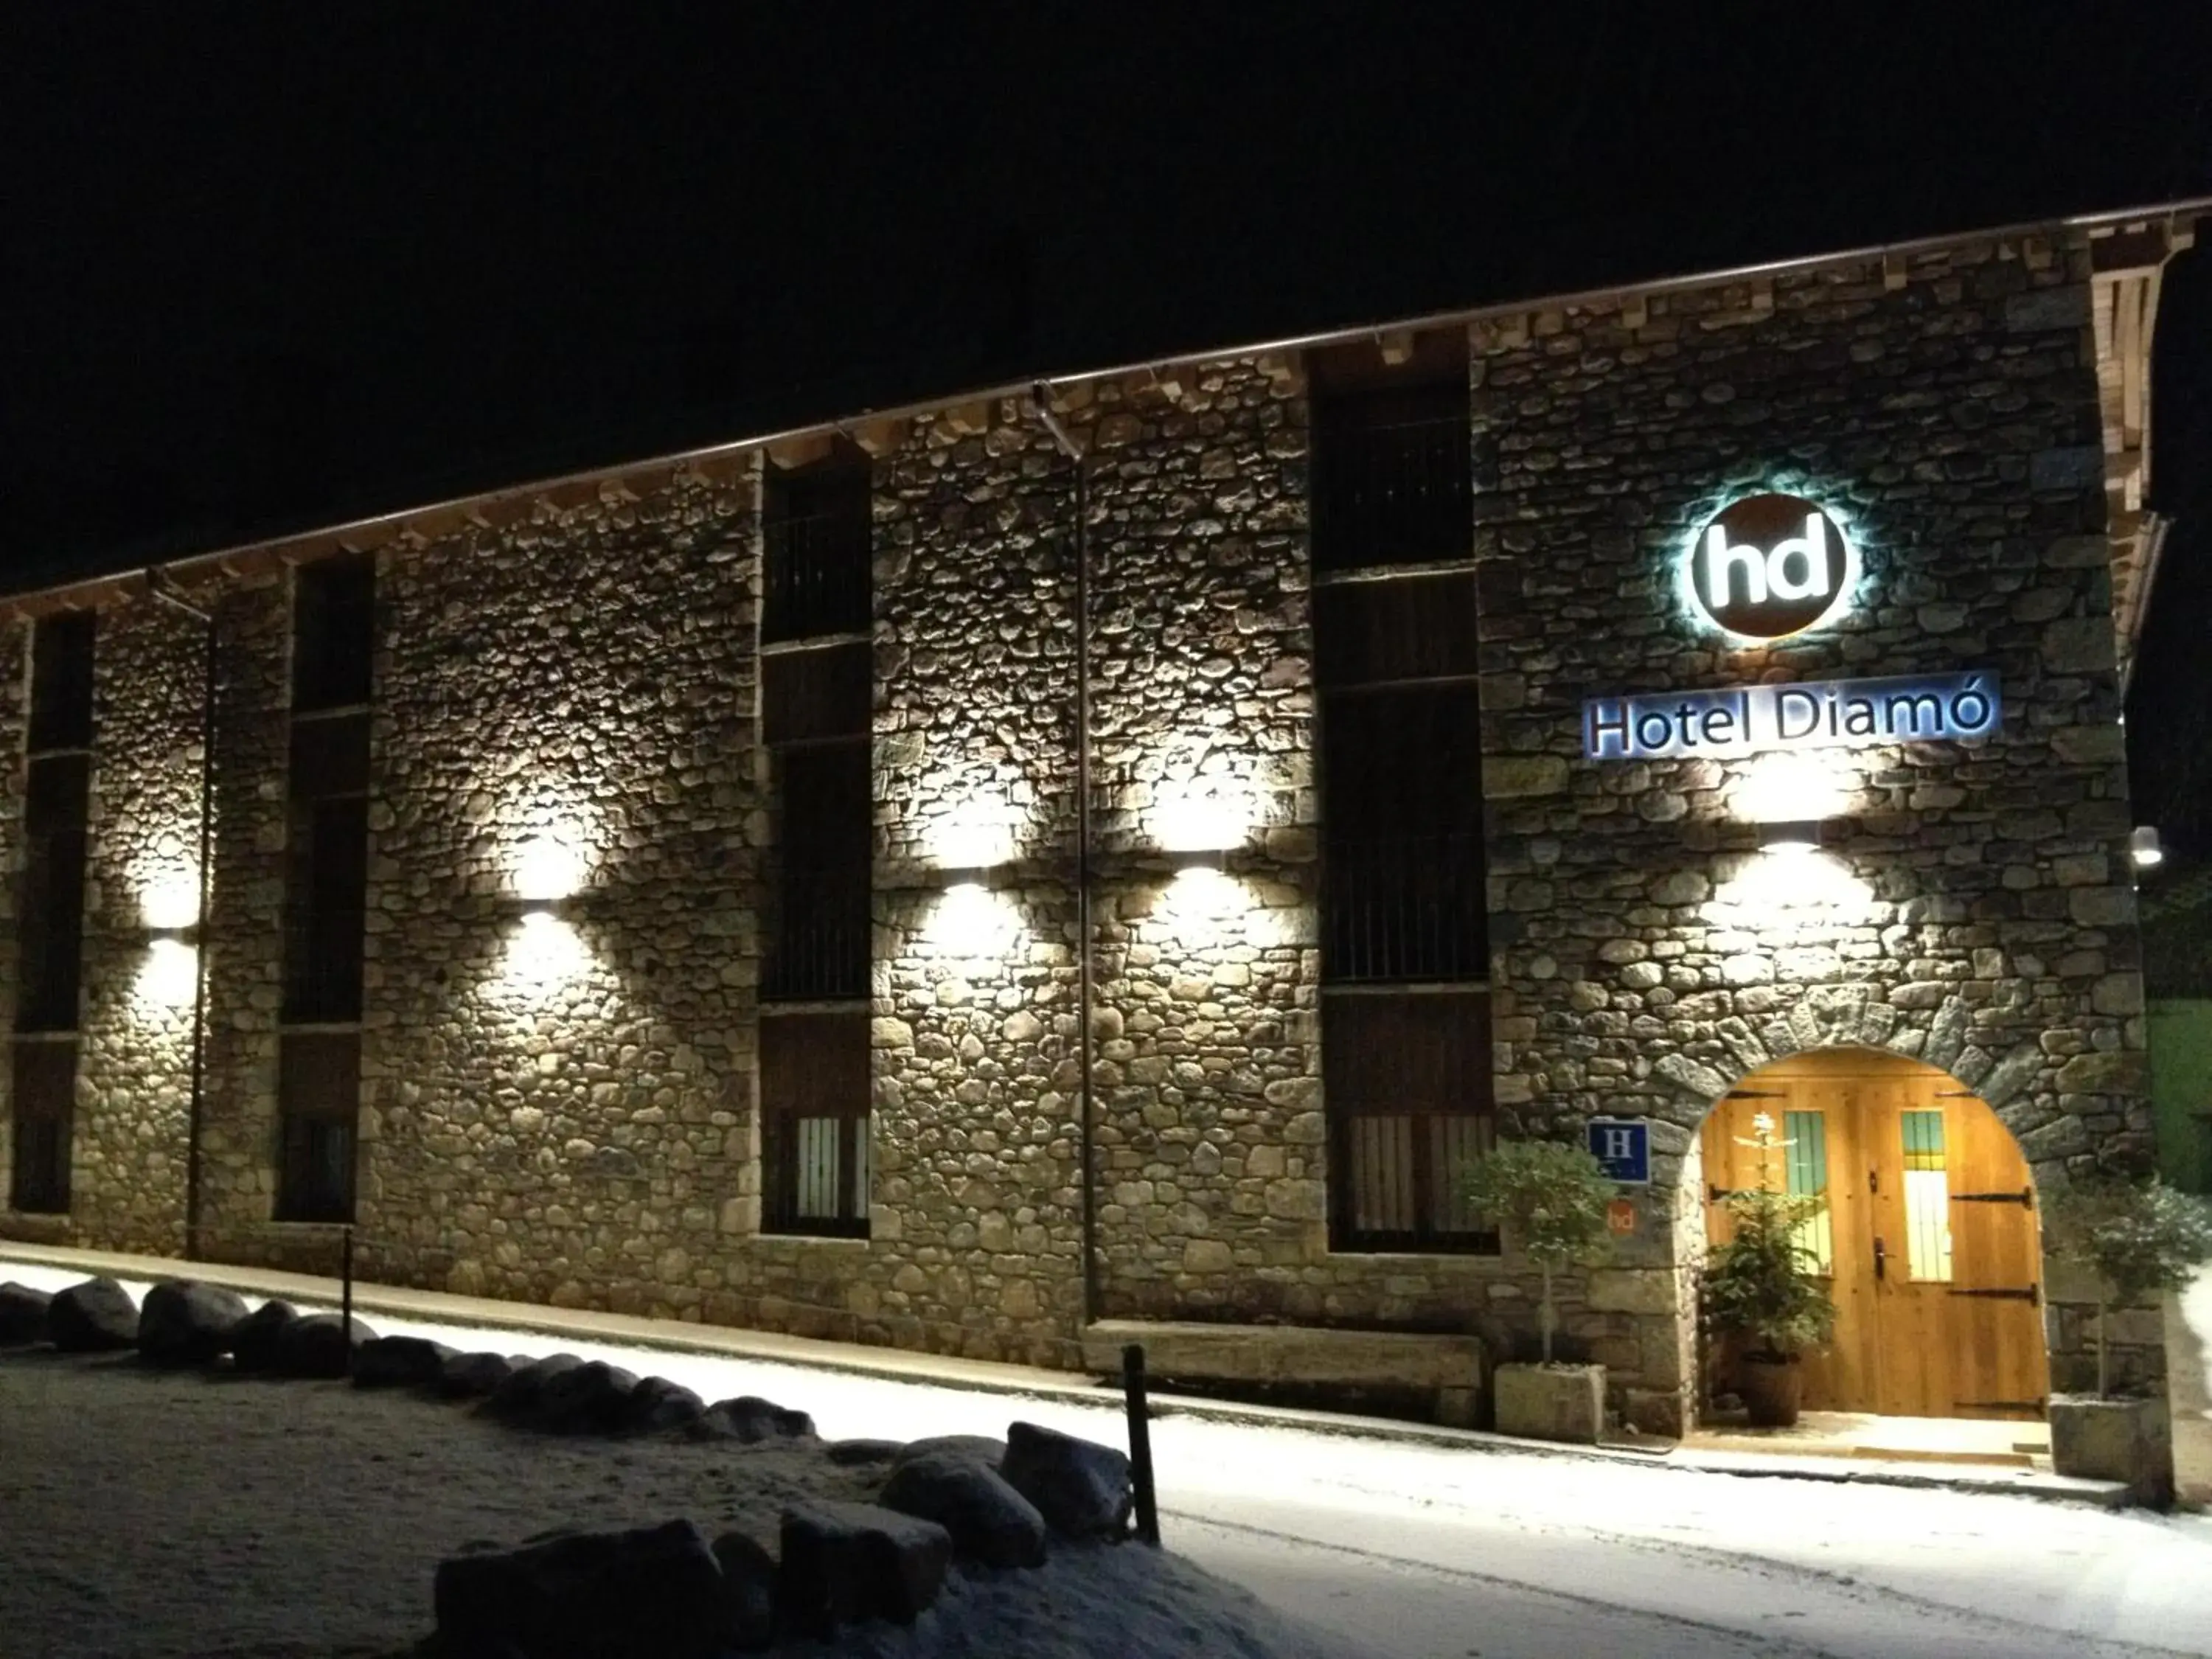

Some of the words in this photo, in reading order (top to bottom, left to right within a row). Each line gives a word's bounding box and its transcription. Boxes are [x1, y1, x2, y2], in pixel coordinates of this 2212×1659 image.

[1705, 513, 1829, 607] hd
[1590, 692, 1750, 754] Hotel
[1776, 676, 1991, 739] Diamó
[1604, 1130, 1632, 1158] H
